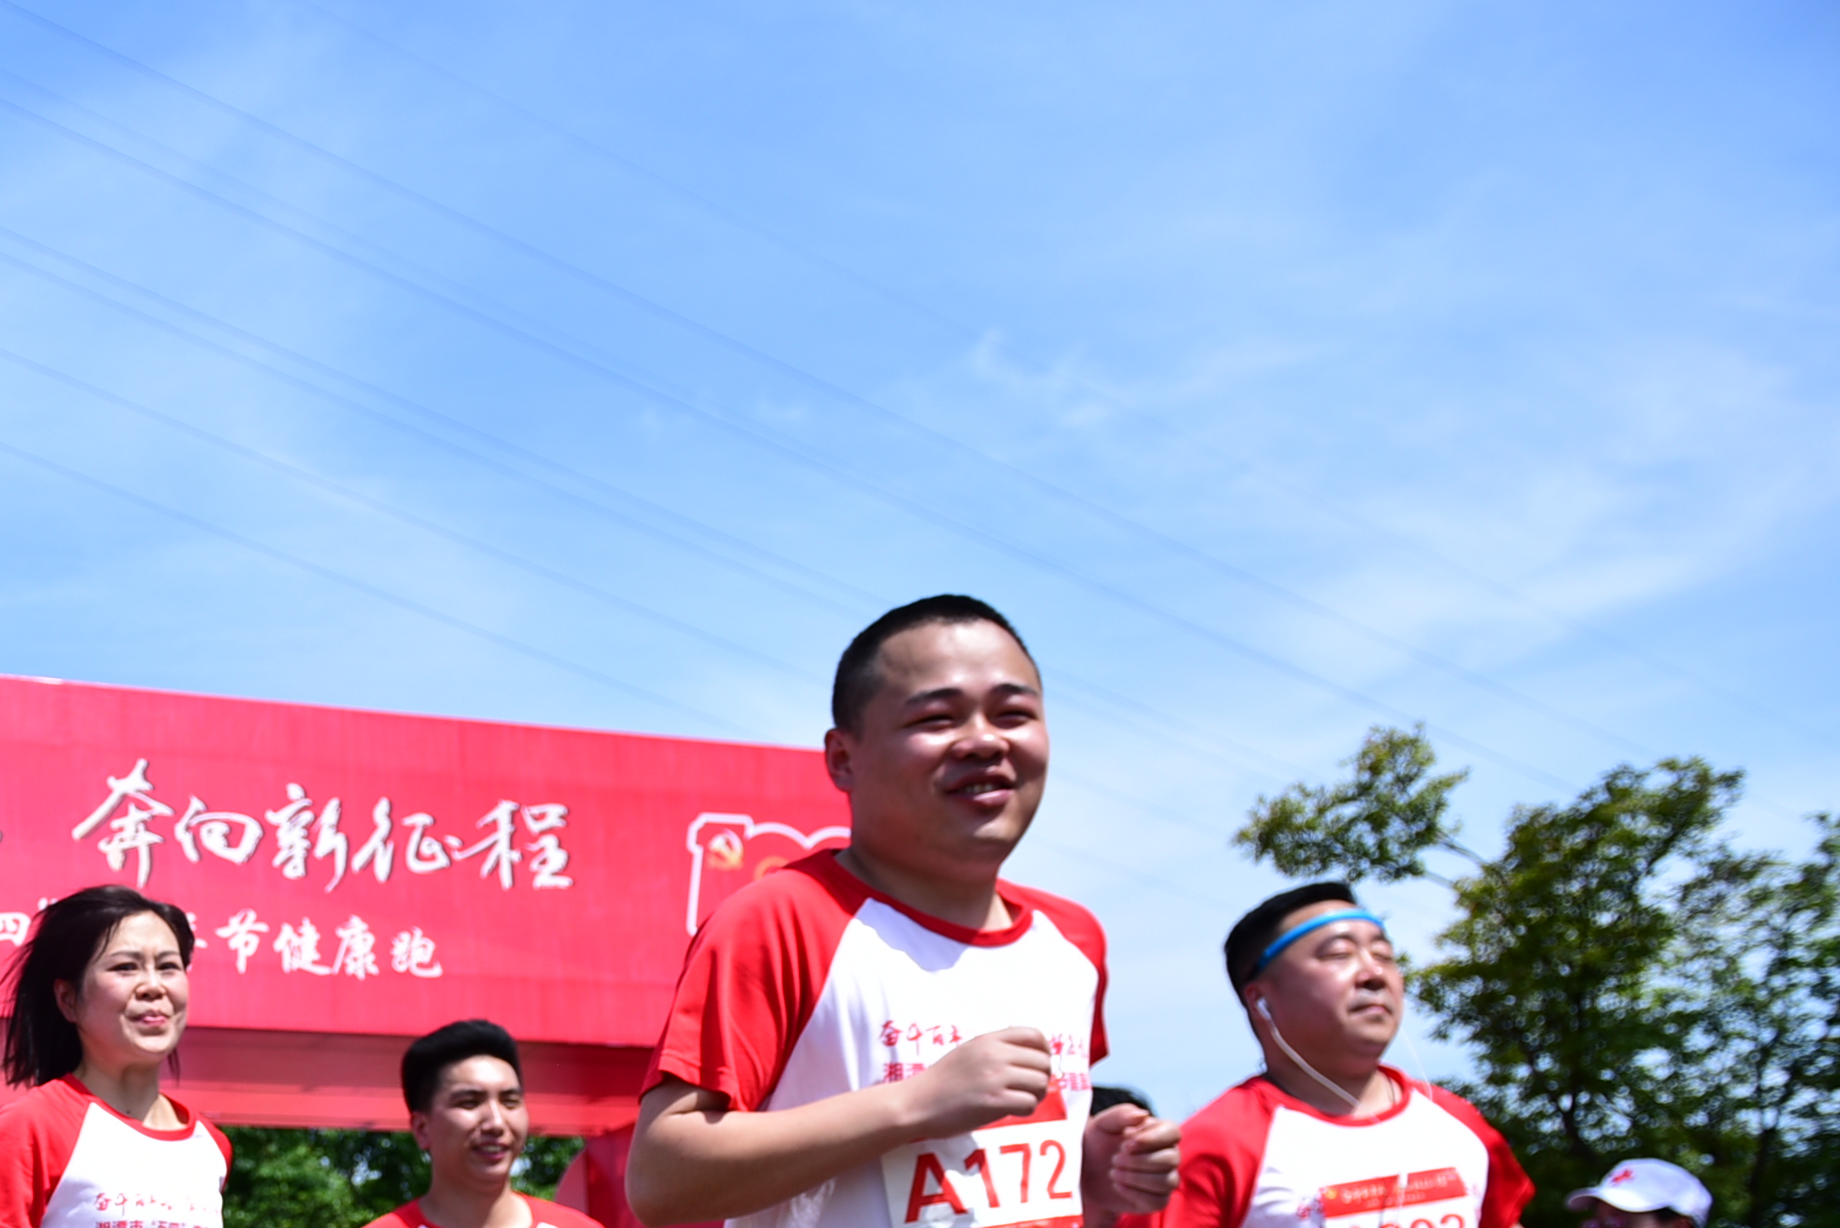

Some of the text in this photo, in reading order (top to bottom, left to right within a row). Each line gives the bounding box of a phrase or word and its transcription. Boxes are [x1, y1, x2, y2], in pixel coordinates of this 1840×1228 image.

[71, 758, 573, 892] 奔向新征程
[904, 1138, 1073, 1224] A172
